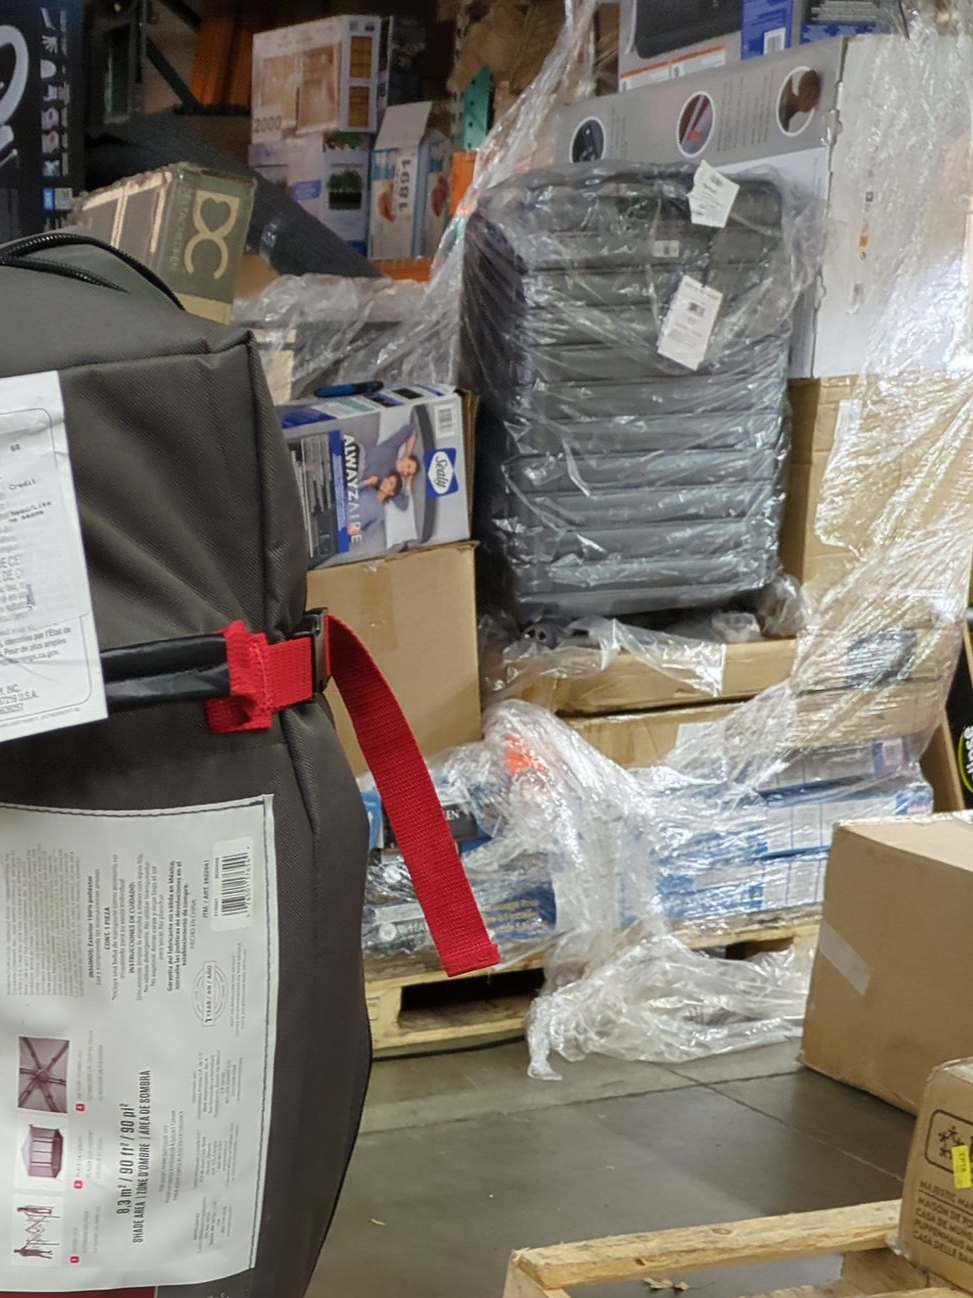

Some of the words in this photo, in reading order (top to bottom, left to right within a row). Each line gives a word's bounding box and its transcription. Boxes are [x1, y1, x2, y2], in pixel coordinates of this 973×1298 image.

[254, 116, 282, 132] 2000
[399, 159, 411, 211] 1891
[435, 456, 446, 489] Sealy
[139, 1070, 151, 1103] SOMBRA
[139, 1105, 150, 1114] DE
[119, 1120, 134, 1133] 90
[119, 1160, 133, 1174] 90
[137, 1143, 150, 1177] D'OMBRE
[136, 1178, 148, 1195] ZONE
[134, 1201, 145, 1218] AREA
[915, 1207, 936, 1224] CASA
[937, 1217, 948, 1227] DE
[918, 1197, 950, 1217] MAISON
[951, 1211, 960, 1221] DE
[132, 1220, 144, 1243] SHADE
[914, 1230, 933, 1246] CASA
